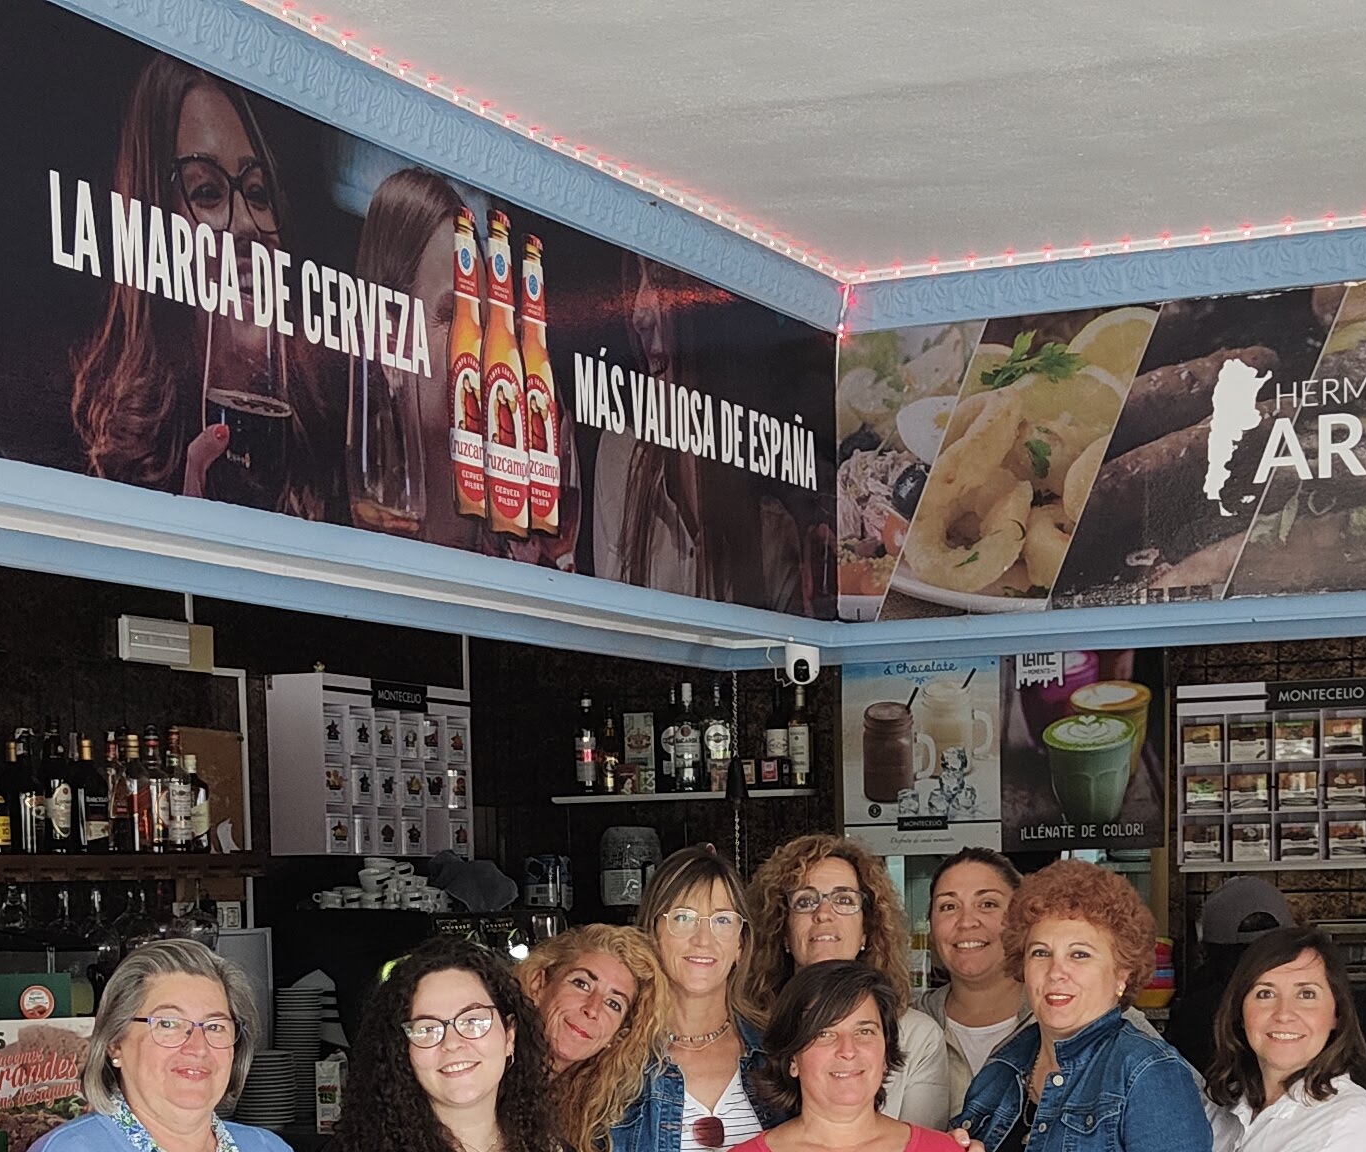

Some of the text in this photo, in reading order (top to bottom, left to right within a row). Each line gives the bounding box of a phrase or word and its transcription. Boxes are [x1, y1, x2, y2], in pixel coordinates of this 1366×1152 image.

[49, 169, 432, 378] LA MARCA DE CERVEZA
[574, 347, 817, 491] MÁS VALIOSA DE ESPAÑA
[896, 661, 958, 674] Chocolate
[377, 689, 422, 704] MONTECELIO
[1278, 687, 1365, 702] MONTECELIO
[1020, 823, 1144, 841] ¡LLÉNATE DE COLOR!
